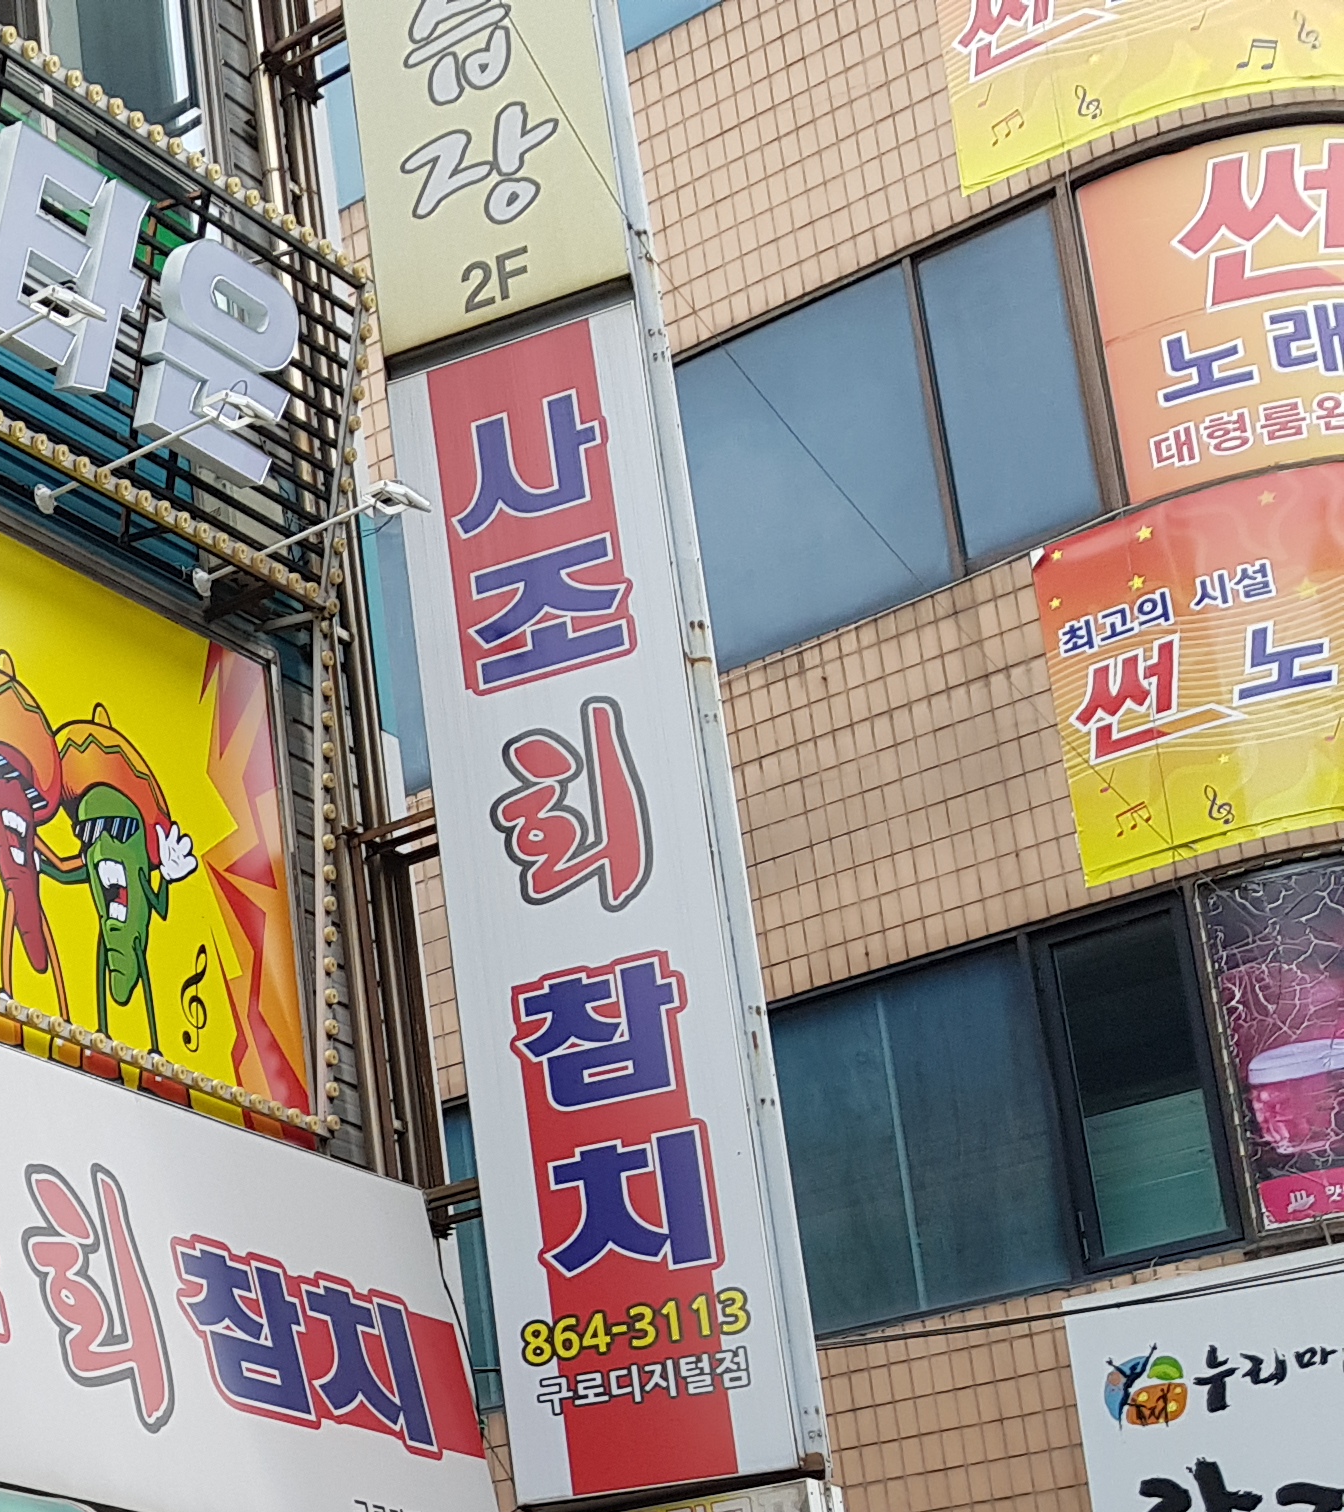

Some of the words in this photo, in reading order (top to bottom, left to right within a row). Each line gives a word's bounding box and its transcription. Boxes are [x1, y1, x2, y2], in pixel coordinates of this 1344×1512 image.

[459, 245, 530, 314] 2F
[1058, 588, 1174, 660] 최고의
[1192, 558, 1279, 611] 시설
[1071, 636, 1244, 765] 썬
[522, 1288, 752, 1367] 864-3113
[537, 1347, 752, 1415] 구로디지털점
[1194, 1342, 1344, 1412] 누리마
